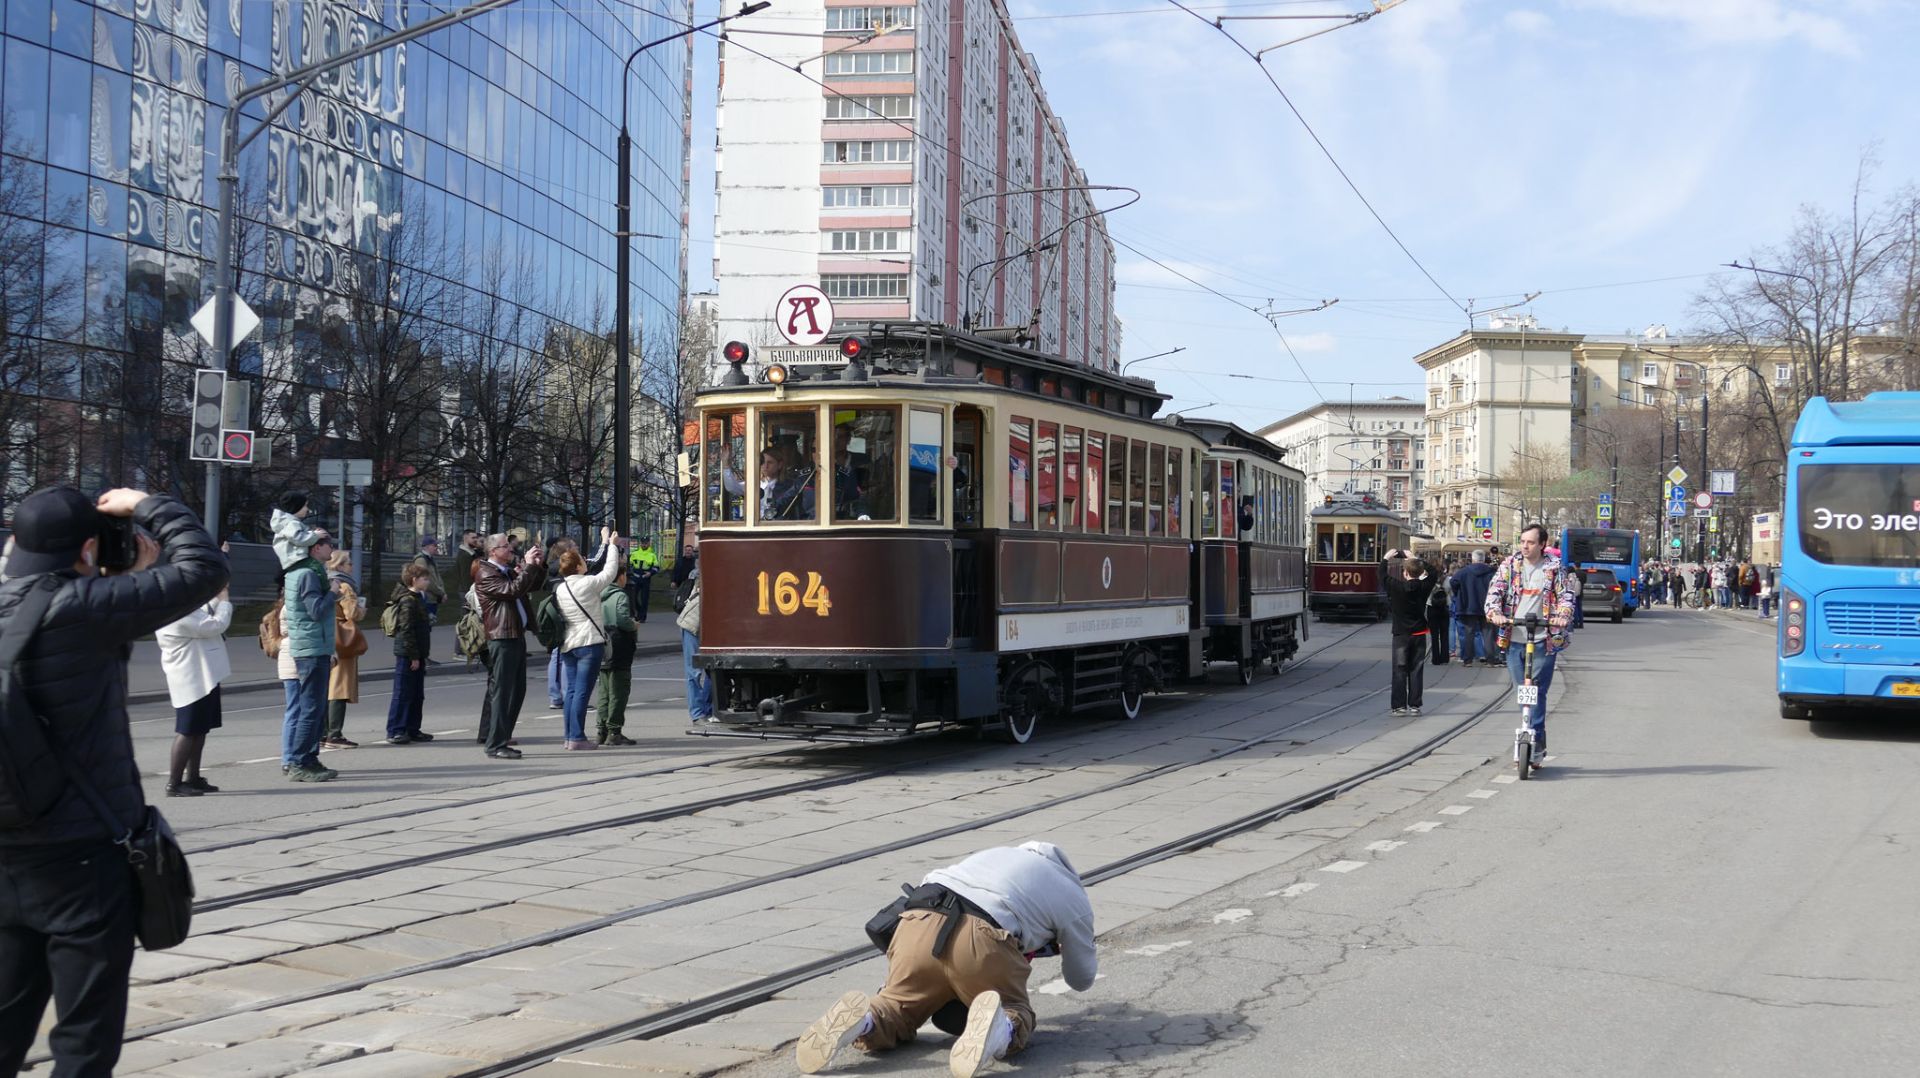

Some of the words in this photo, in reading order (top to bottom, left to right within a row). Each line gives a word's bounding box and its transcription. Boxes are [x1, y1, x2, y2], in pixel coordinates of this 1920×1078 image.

[770, 350, 842, 362] БУЛЬВАРНАЯ
[1813, 507, 1863, 530] Это
[1870, 514, 1920, 531] эле
[1330, 572, 1361, 585] 2170
[757, 571, 832, 617] 164
[1005, 619, 1019, 641] 164
